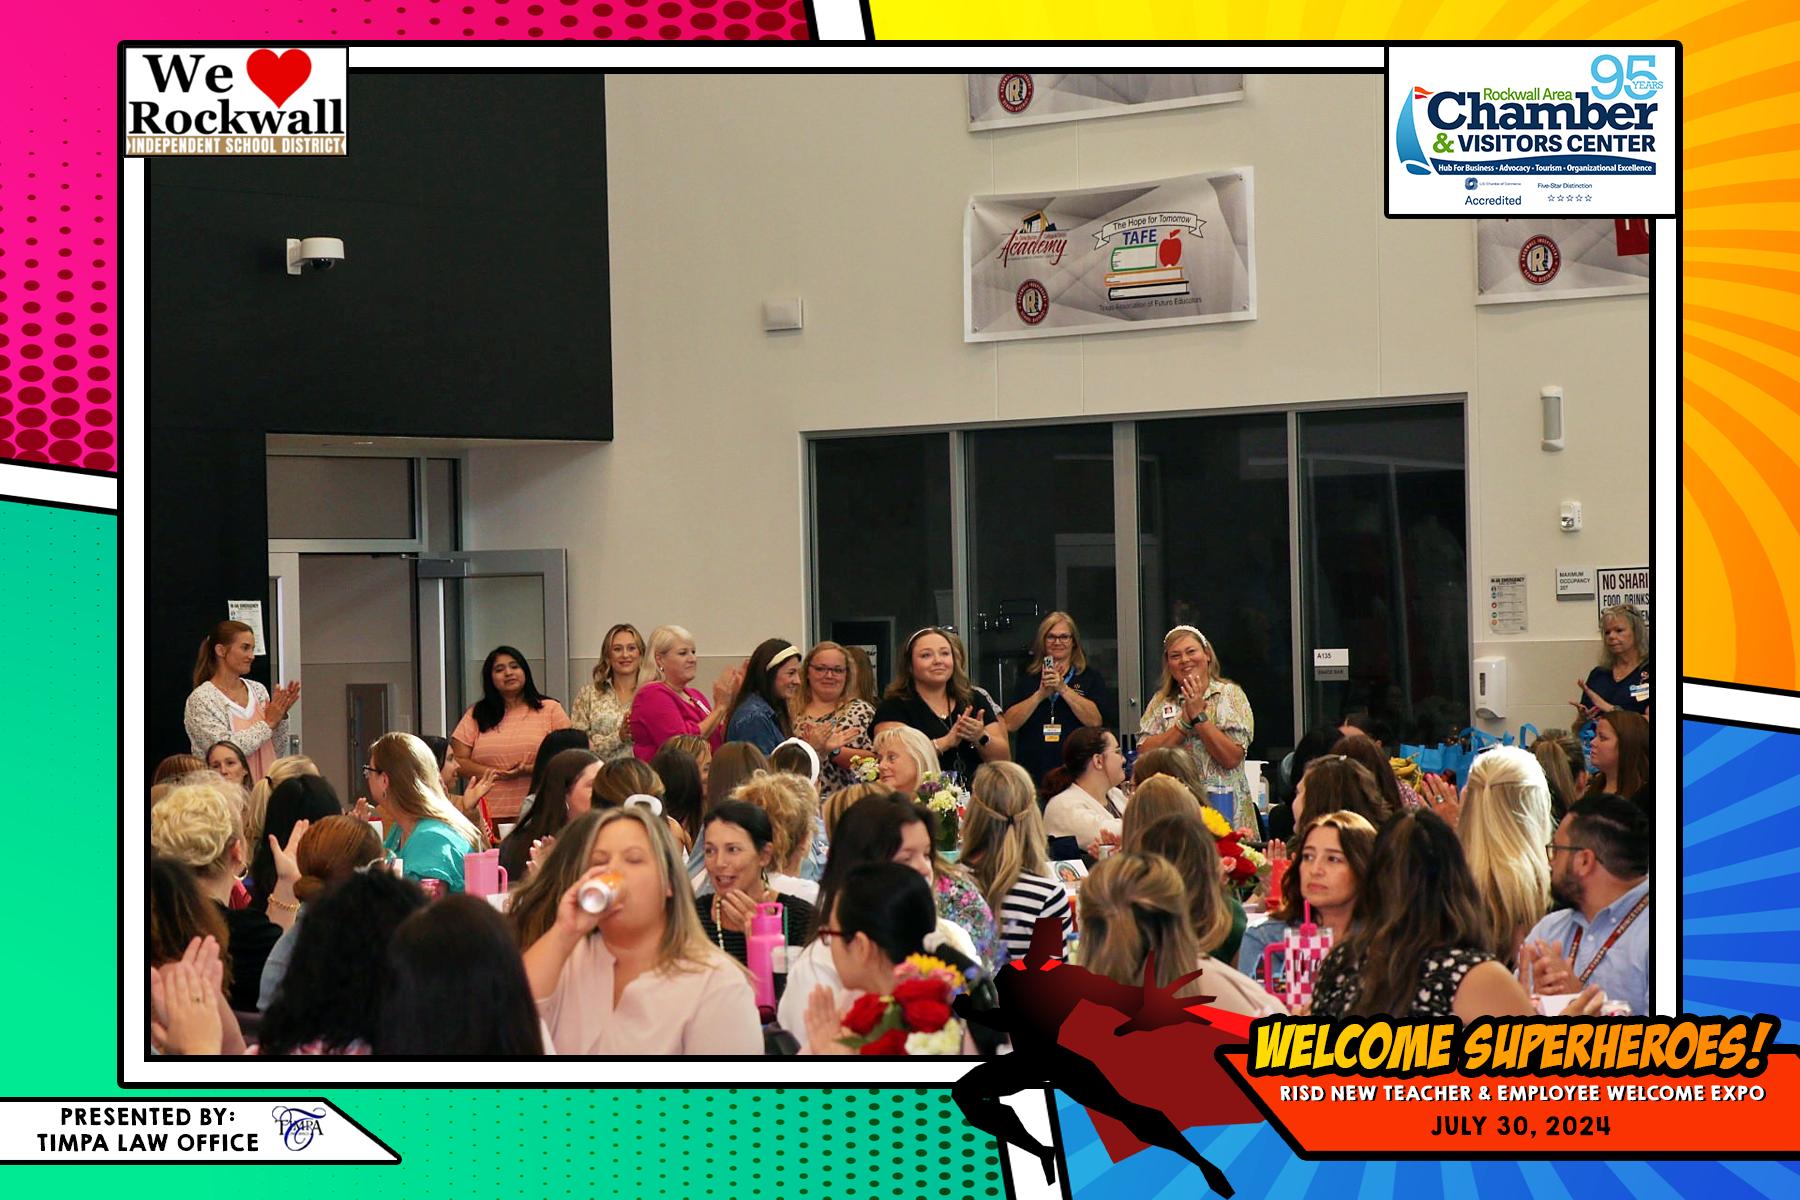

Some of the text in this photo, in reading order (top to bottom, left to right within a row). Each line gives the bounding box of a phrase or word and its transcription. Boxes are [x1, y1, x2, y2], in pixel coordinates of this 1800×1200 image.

[1112, 214, 1192, 231] The Hope for Tomorrow
[1122, 228, 1157, 246] TAFE
[995, 228, 1068, 269] Academy
[1602, 573, 1616, 590] NO
